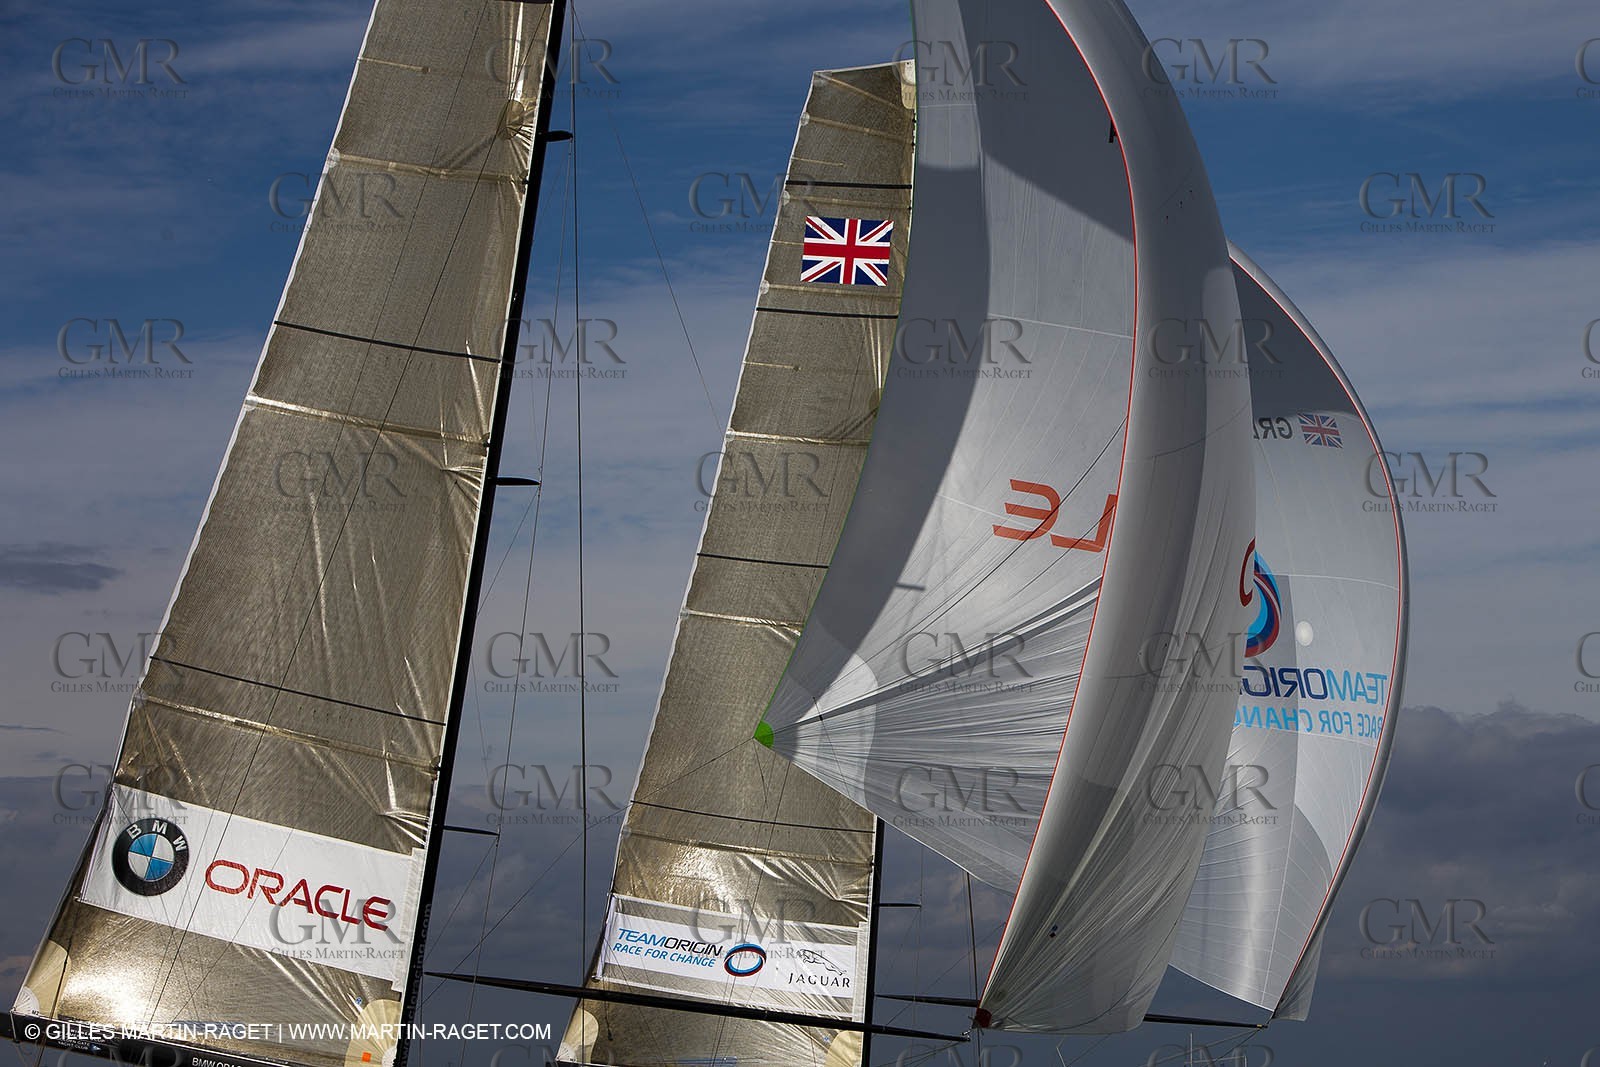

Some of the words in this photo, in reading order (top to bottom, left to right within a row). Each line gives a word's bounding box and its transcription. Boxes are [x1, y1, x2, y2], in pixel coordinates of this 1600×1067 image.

[126, 819, 189, 854] BMW
[205, 859, 392, 932] ORACLE
[612, 943, 643, 957] RACE
[643, 947, 668, 961] FOR
[669, 952, 717, 969] CHANGE
[618, 928, 724, 957] TEAMORIGIN
[787, 972, 852, 989] JAGUAR
